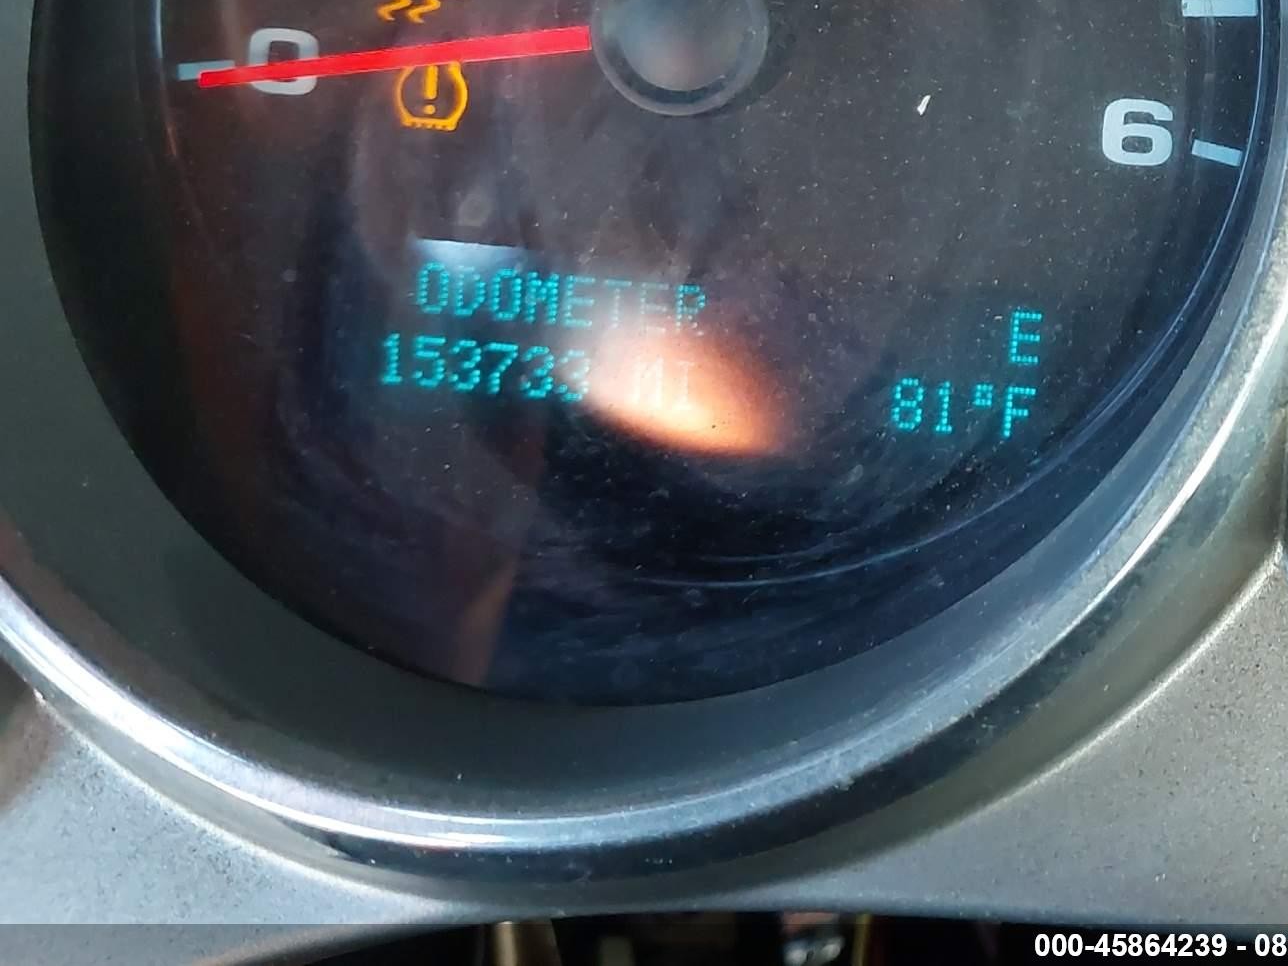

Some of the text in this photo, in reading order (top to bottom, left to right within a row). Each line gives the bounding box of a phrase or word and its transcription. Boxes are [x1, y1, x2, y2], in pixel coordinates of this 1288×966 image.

[248, 28, 318, 97] 0
[1102, 98, 1174, 167] 6
[416, 262, 706, 334] ODOMETER
[1010, 311, 1043, 366] E
